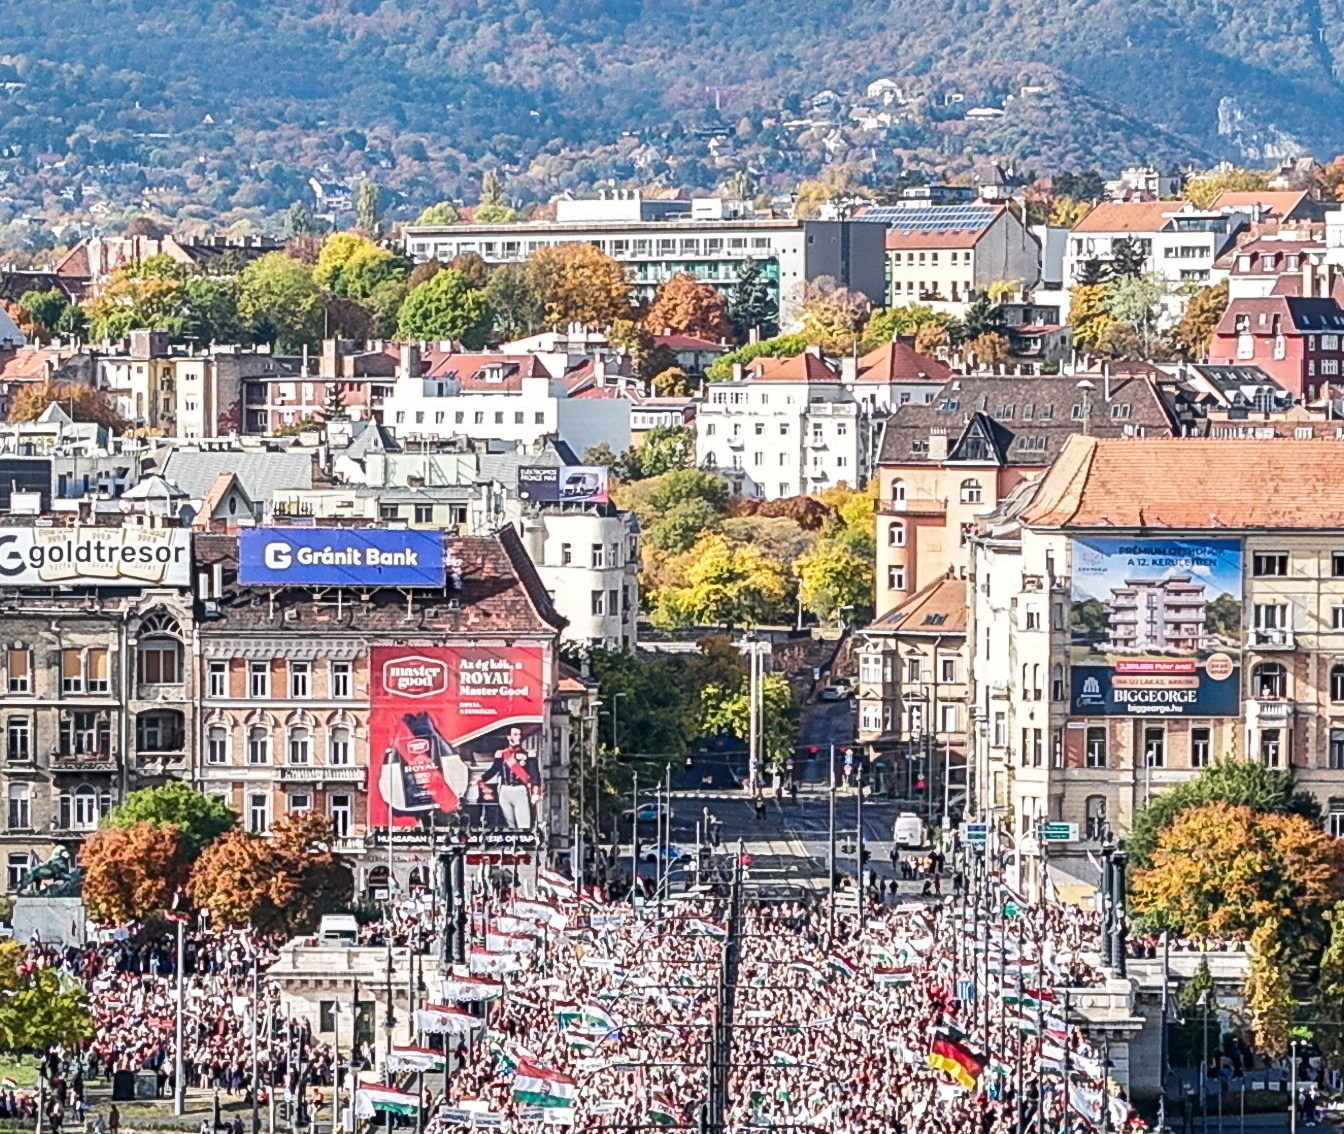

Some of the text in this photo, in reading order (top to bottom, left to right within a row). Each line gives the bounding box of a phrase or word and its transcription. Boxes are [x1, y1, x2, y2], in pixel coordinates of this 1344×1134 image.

[29, 540, 185, 568] goldtresor
[297, 546, 362, 566] Gránit
[366, 548, 418, 566] Bank
[390, 665, 441, 677] master
[398, 675, 434, 690] good
[459, 672, 513, 685] ROYAL
[459, 685, 529, 696] Master Good
[1113, 689, 1197, 703] BIGGEORGE
[1127, 704, 1183, 714] biggeorge.hu
[404, 763, 439, 773] ROYAL
